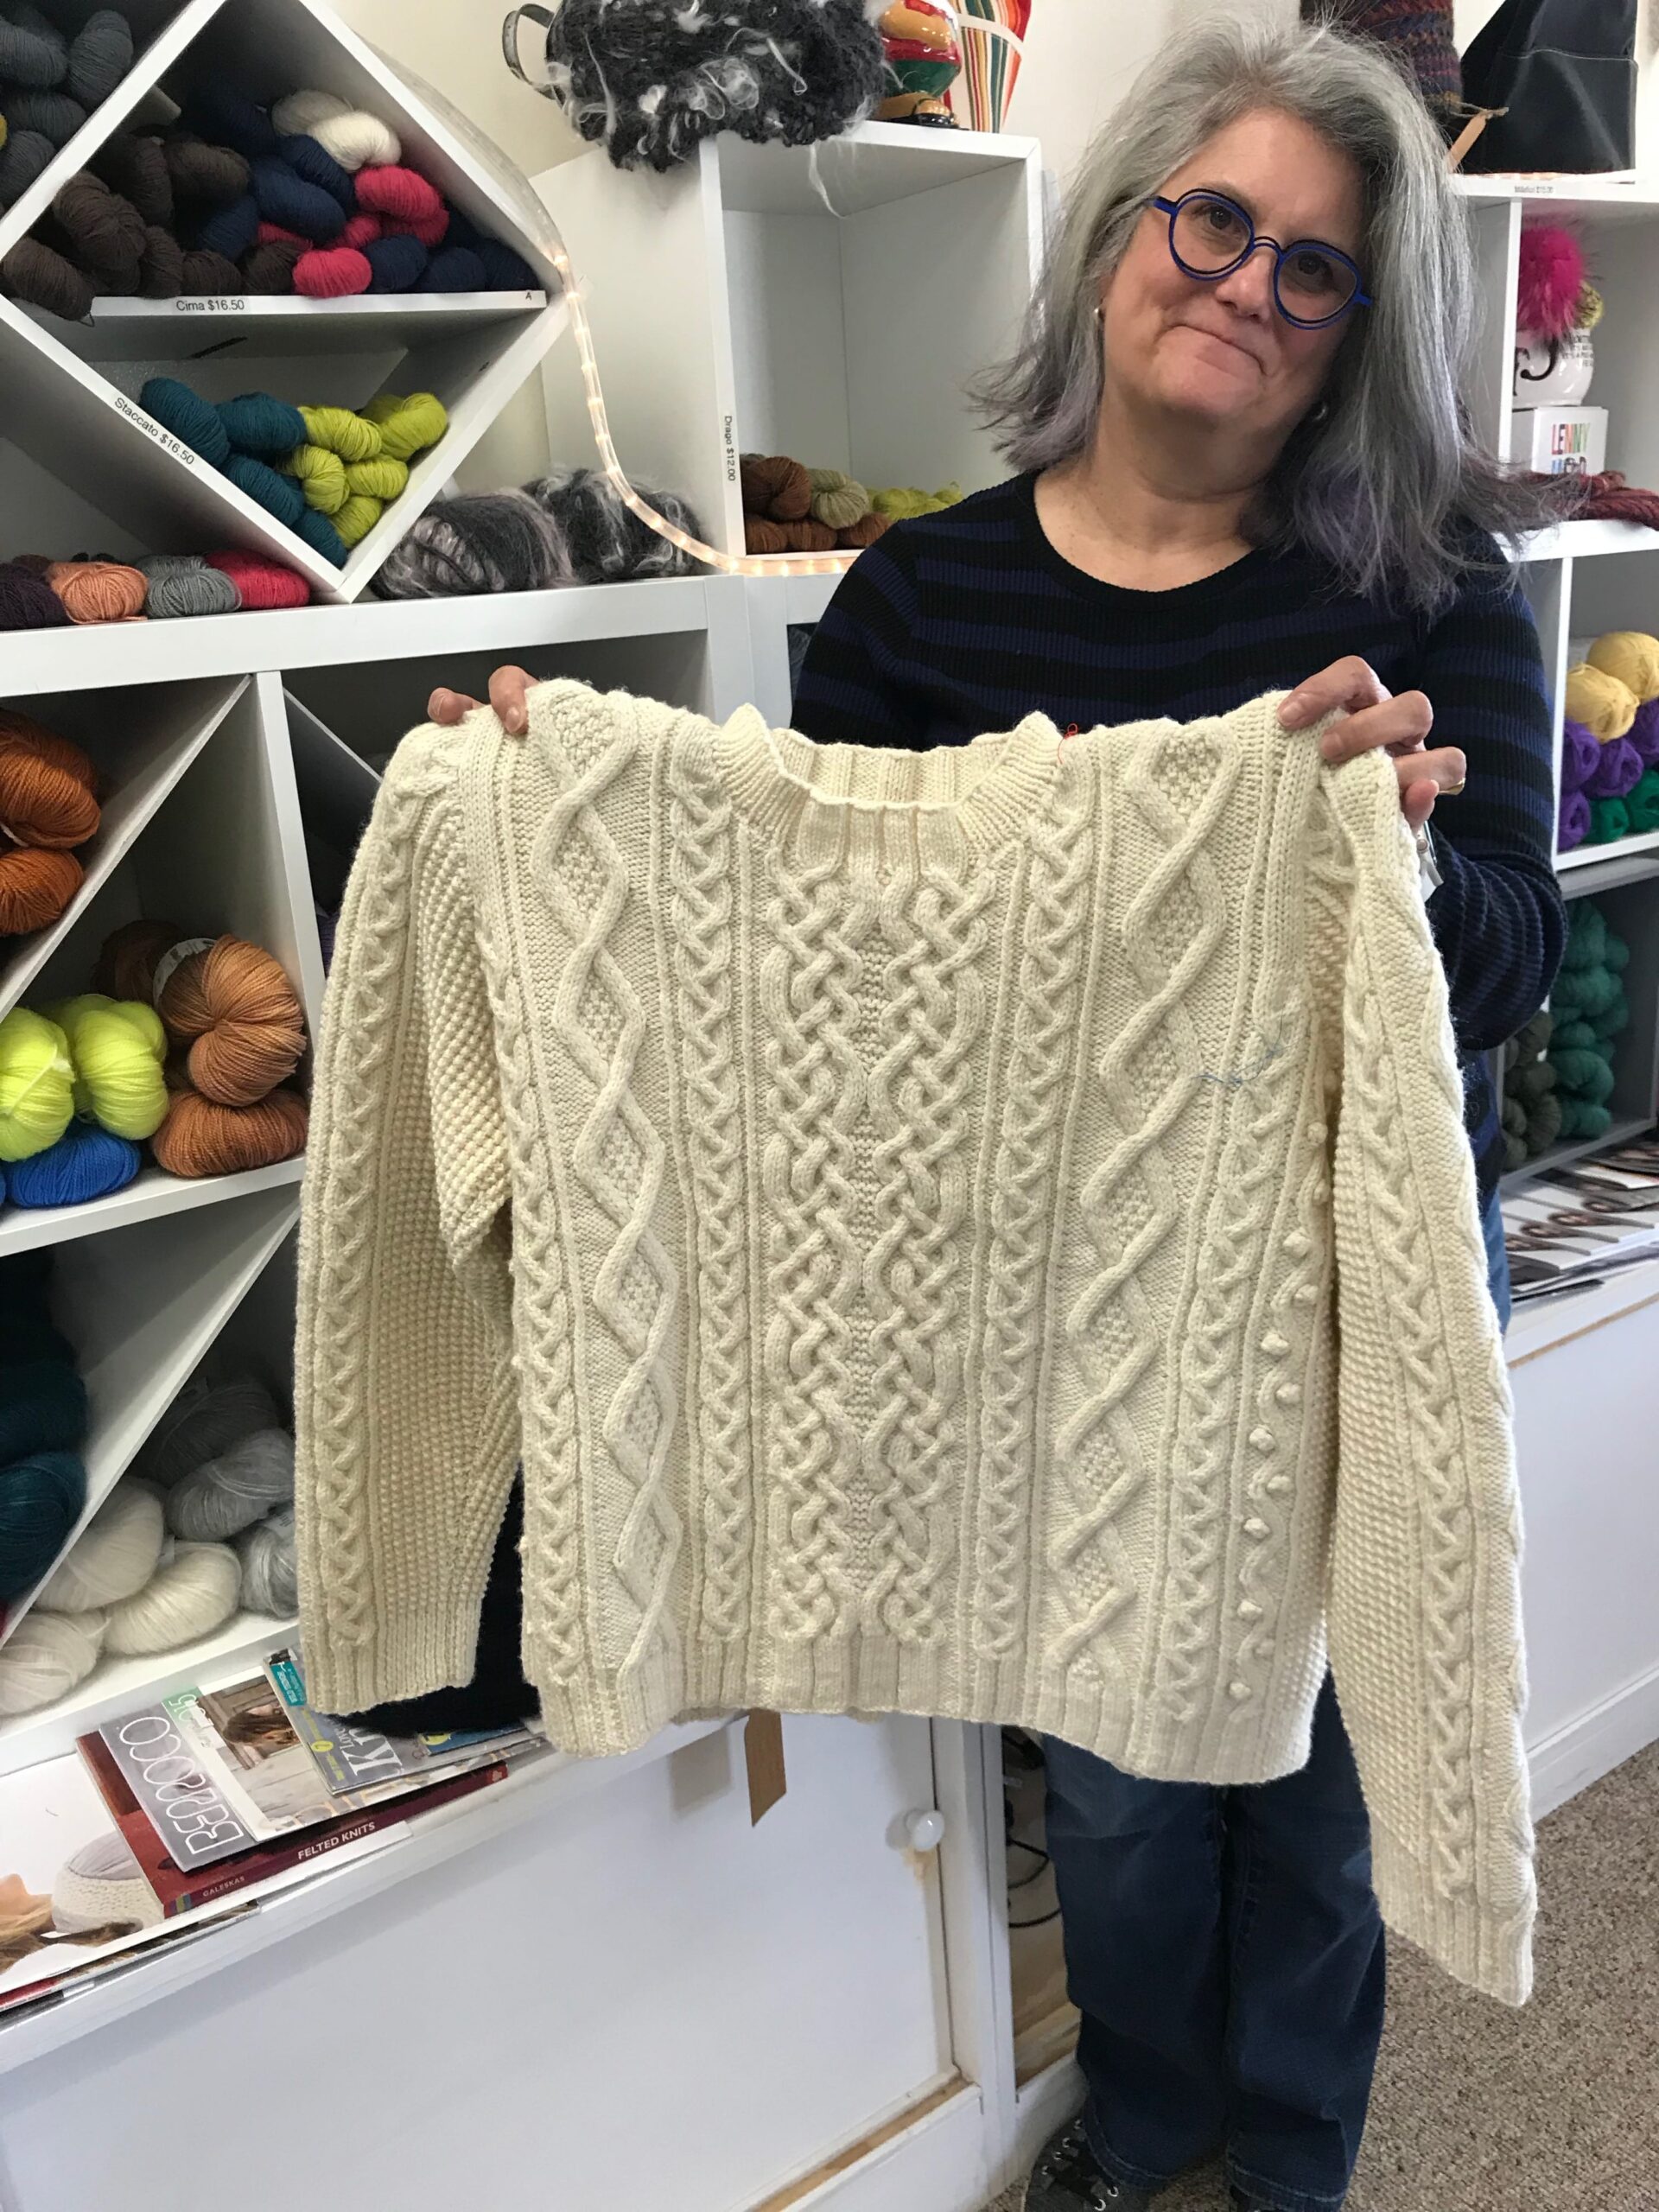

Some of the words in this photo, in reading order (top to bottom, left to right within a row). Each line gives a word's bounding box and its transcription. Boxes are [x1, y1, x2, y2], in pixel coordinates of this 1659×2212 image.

[176, 300, 205, 311] Cima
[208, 299, 245, 311] $16.50
[115, 397, 158, 436] Staccato
[160, 434, 194, 464] $16.50
[727, 448, 736, 481] $12.00
[119, 1716, 244, 1854] BERROCO
[297, 1836, 339, 1859] FELTED
[341, 1821, 376, 1842] KNITS
